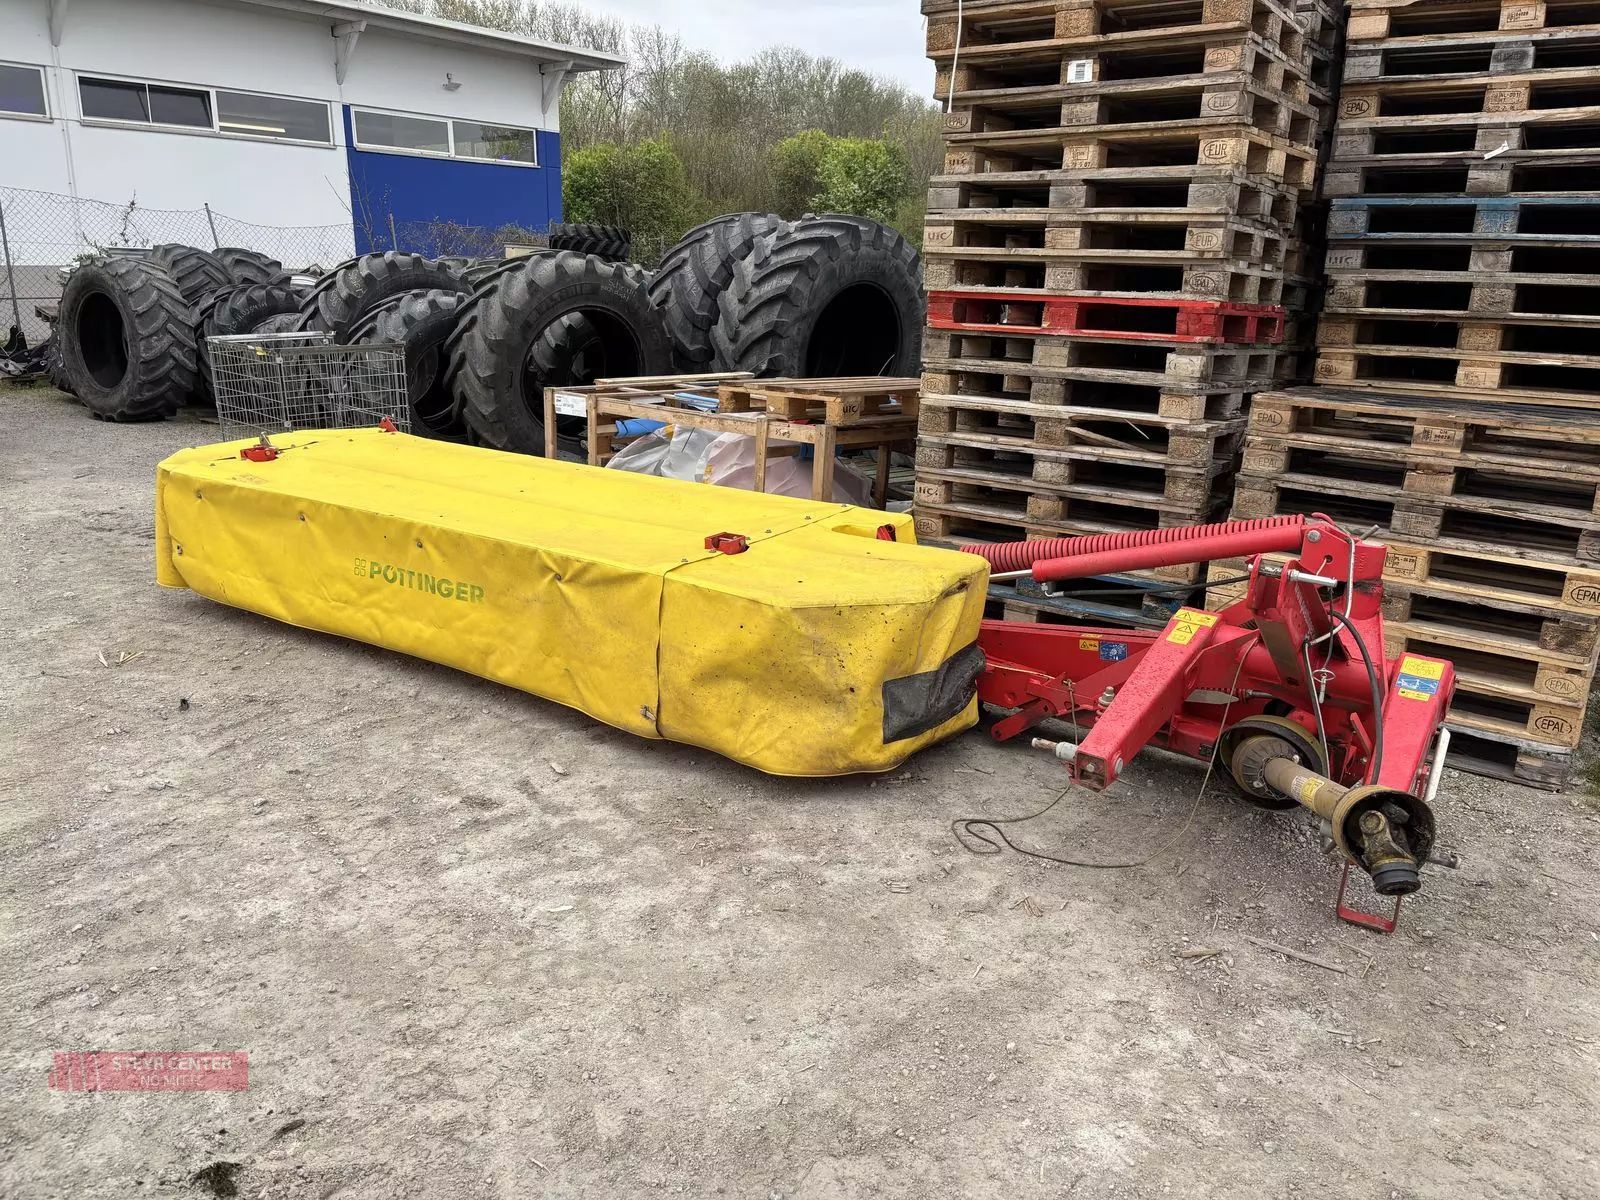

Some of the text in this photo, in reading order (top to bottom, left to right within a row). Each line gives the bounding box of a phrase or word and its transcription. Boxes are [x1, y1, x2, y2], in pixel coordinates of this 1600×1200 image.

[1346, 102, 1365, 112] EPAL
[1208, 143, 1227, 157] EUR
[1195, 236, 1213, 247] EUR
[1257, 412, 1278, 424] EPAL
[1258, 457, 1278, 468] EPAL
[1576, 588, 1600, 604] EPAL
[1549, 680, 1571, 692] EPAL
[1541, 718, 1565, 733] EPAL
